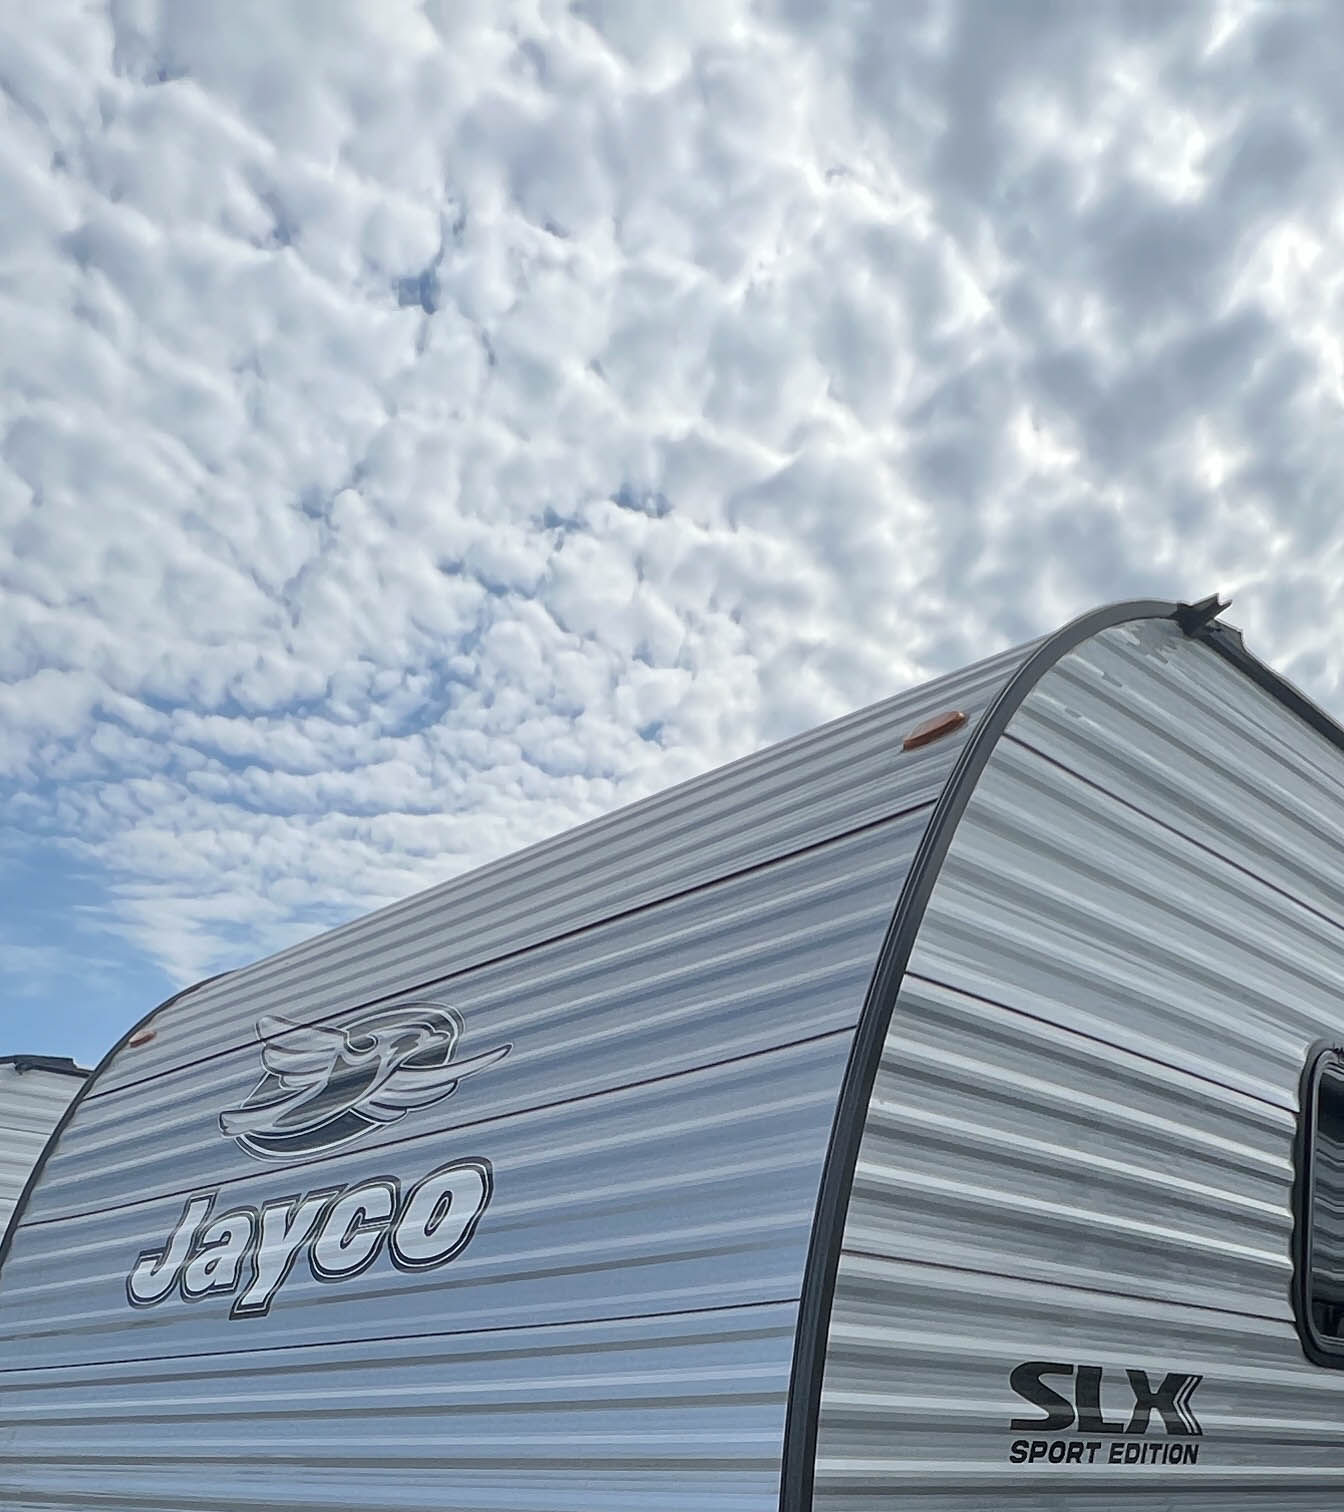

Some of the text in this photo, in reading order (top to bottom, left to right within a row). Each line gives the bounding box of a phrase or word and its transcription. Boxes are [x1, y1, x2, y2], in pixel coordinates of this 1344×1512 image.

[126, 1156, 494, 1320] Jayco
[1010, 1361, 1204, 1436] SLX
[1009, 1440, 1200, 1465] SPORT EDITION
